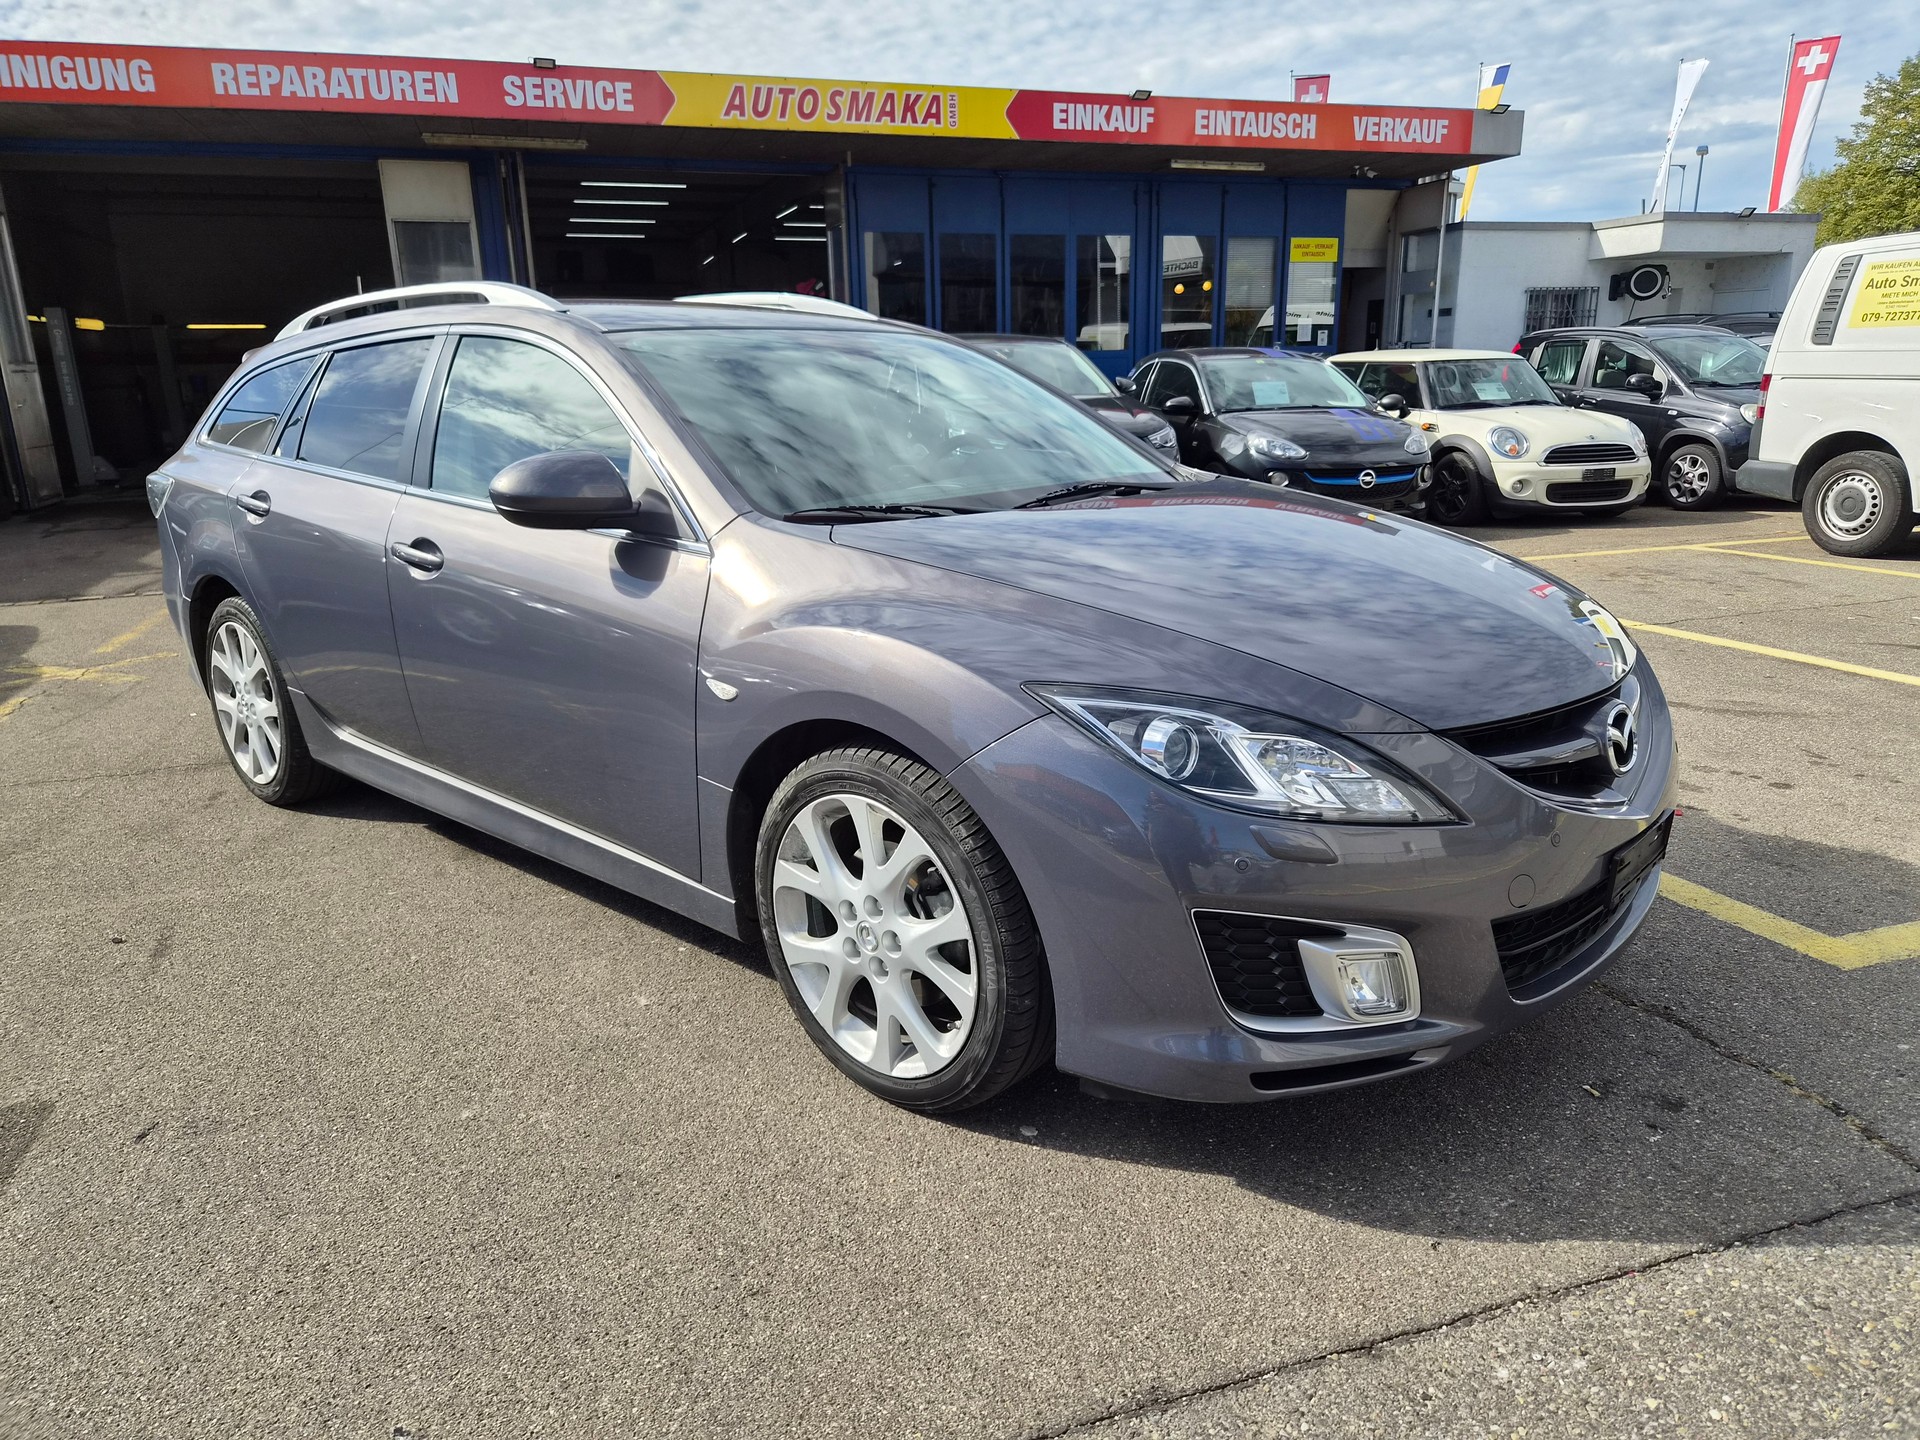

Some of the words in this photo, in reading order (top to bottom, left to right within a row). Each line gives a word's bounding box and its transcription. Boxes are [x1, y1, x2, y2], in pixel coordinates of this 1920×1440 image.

[211, 62, 458, 104] REPARATUREN
[503, 75, 634, 112] SERVICE
[723, 85, 820, 120] AUTO
[826, 90, 942, 125] SMAKA
[948, 94, 957, 128] GMBH
[1052, 102, 1155, 133] EINKAUF
[1194, 109, 1317, 140] EINTAUSCH
[1353, 116, 1449, 144] VERKAUF
[1865, 277, 1897, 290] Auto
[1881, 291, 1901, 299] MIETE
[970, 895, 998, 990] YOKOHAMA
